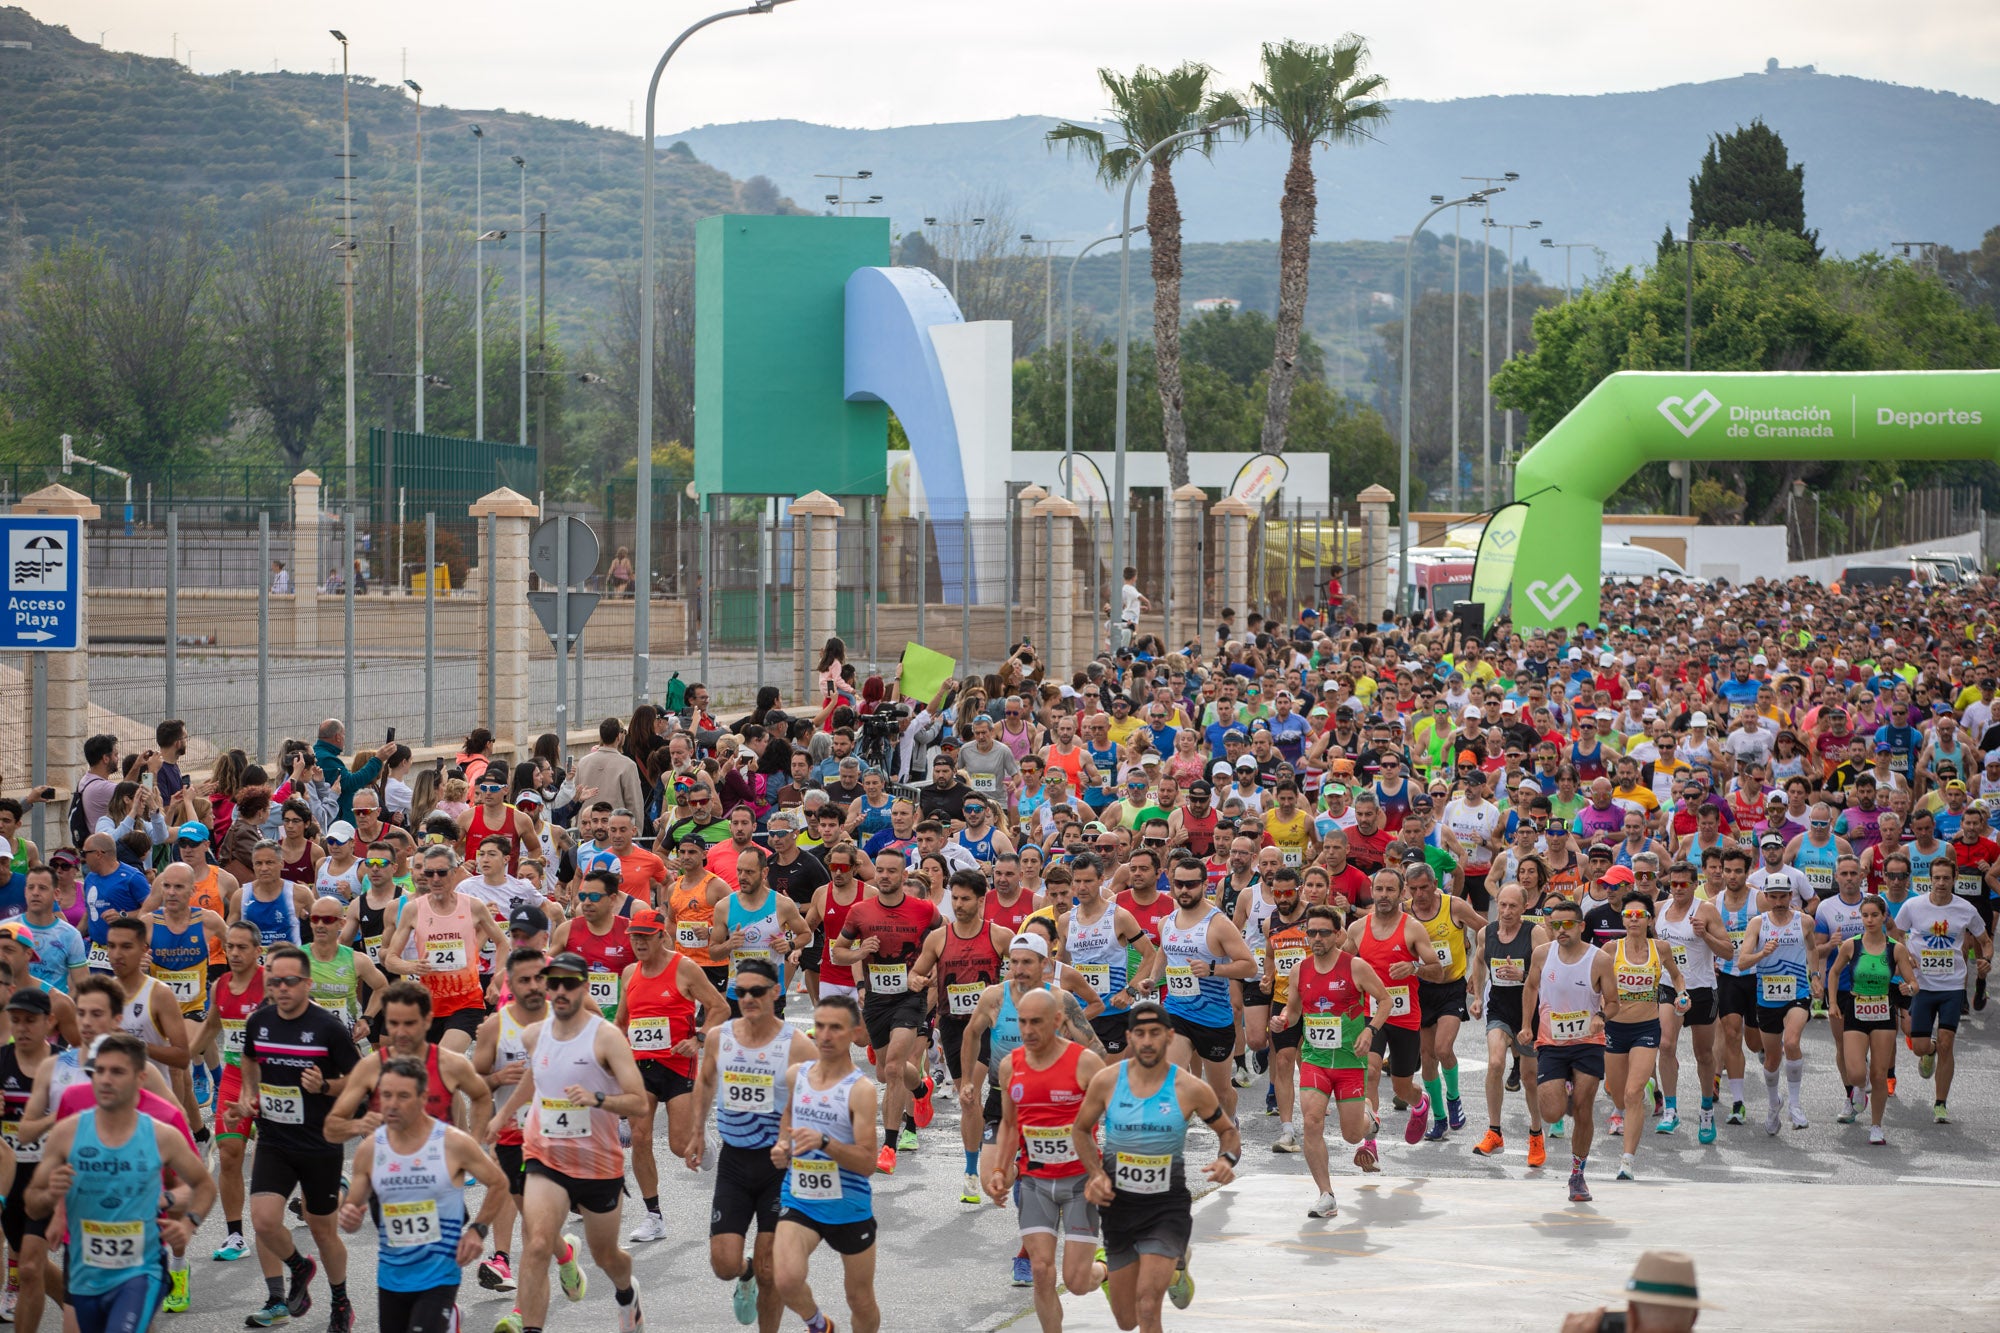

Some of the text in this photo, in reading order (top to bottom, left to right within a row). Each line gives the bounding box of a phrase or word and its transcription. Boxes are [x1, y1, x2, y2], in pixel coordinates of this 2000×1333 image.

[1729, 405, 1831, 424] Diputación
[1877, 408, 1983, 428] Deportes
[1726, 423, 1834, 438] de Granada
[8, 597, 66, 611] Acceso
[15, 612, 59, 629] Playa
[975, 779, 992, 787] 885
[1958, 881, 1977, 890] 296
[427, 932, 462, 941] MOTRIL
[680, 931, 699, 941] 58
[1073, 937, 1109, 949] MARACENA
[1163, 944, 1199, 955] MARACENA
[155, 945, 201, 958] agustinos
[435, 952, 455, 964] 24
[1922, 958, 1953, 968] 3245
[875, 975, 901, 987] 185
[1170, 977, 1193, 989] 633
[1618, 974, 1652, 986] 2026
[165, 982, 191, 994] 71
[1768, 984, 1792, 995] 214
[953, 994, 980, 1007] 169
[1856, 1004, 1888, 1015] 2008
[1557, 1020, 1585, 1033] 117
[634, 1029, 663, 1042] 234
[1310, 1028, 1335, 1041] 872
[729, 1086, 765, 1102] 985
[266, 1097, 295, 1114] 382
[557, 1113, 569, 1128] 4
[794, 1106, 839, 1122] MARACENA
[1034, 1140, 1068, 1155] 555
[78, 1159, 132, 1176] nerja
[381, 1174, 436, 1187] MARACENA
[799, 1173, 832, 1189] 896
[1118, 1166, 1166, 1183] 4031
[391, 1216, 430, 1235] 913
[90, 1238, 134, 1256] 532
